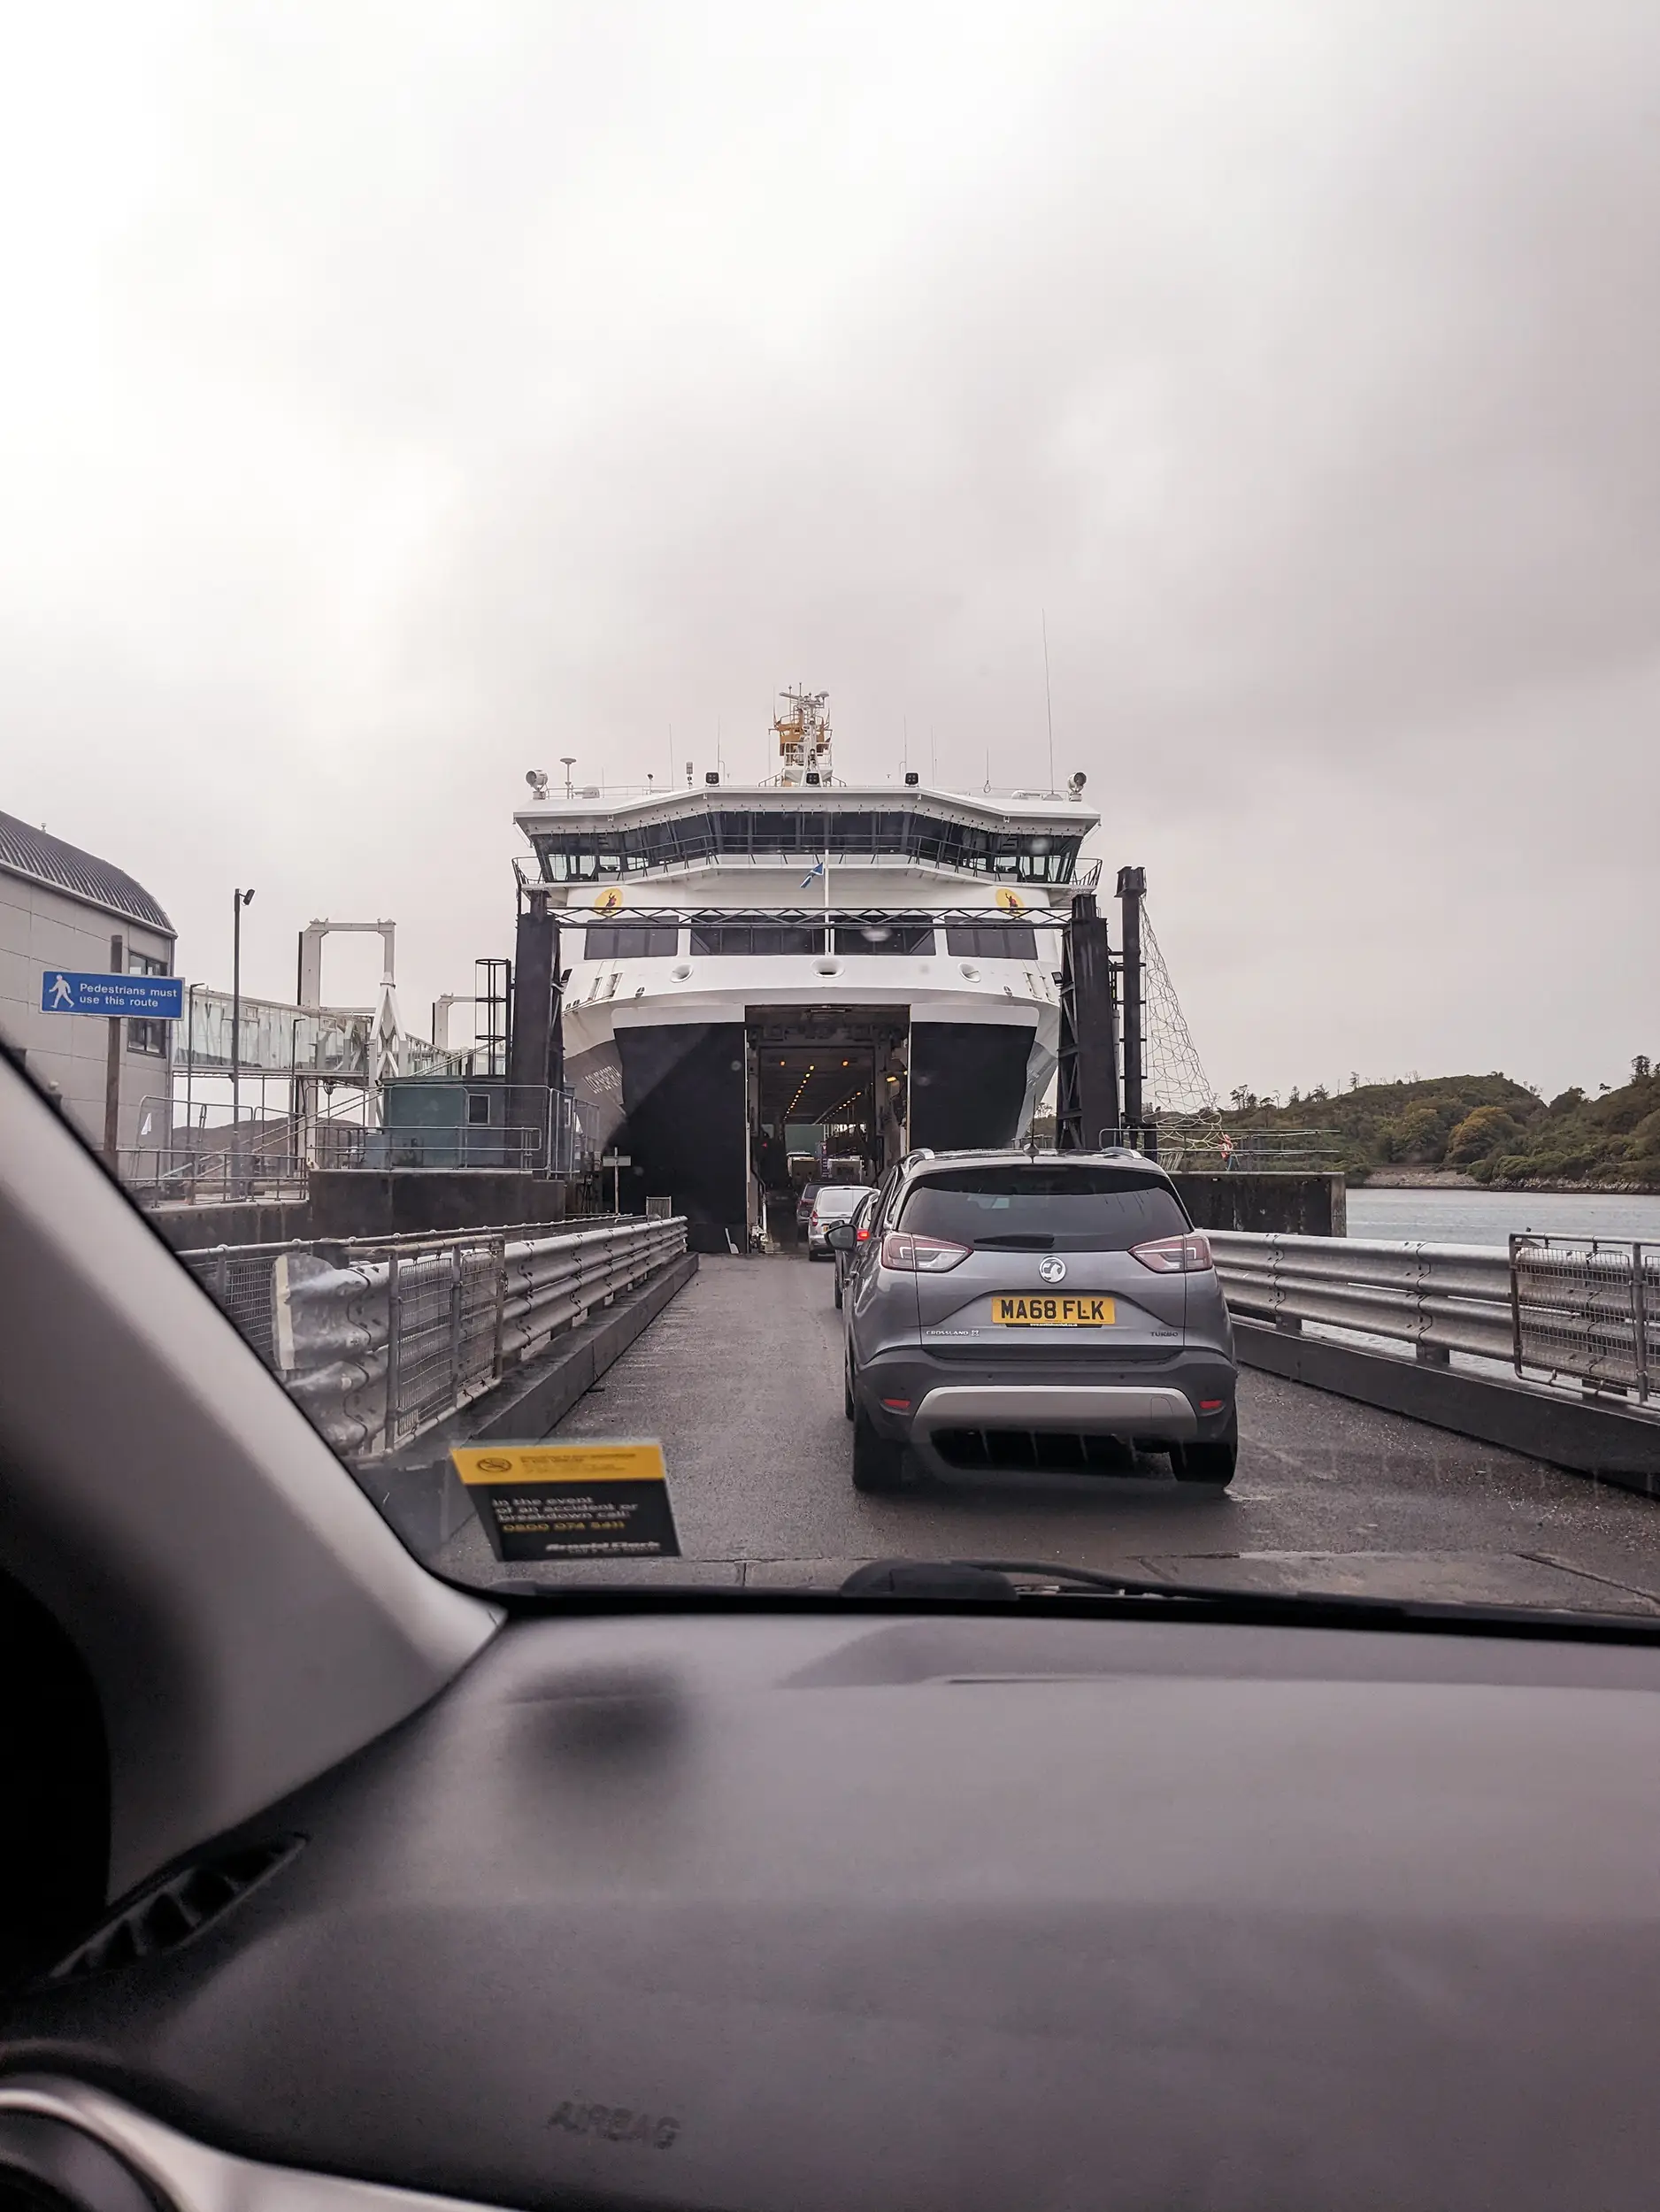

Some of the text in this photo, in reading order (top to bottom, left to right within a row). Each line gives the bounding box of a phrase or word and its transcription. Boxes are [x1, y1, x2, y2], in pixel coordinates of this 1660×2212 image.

[80, 983, 178, 997] Pedestrians must
[104, 996, 126, 1006] this
[129, 998, 159, 1008] route
[1001, 1300, 1104, 1320] MA68 FLK
[495, 1505, 512, 1514] of
[543, 1503, 615, 1513] accident
[497, 1511, 593, 1522] breakdown
[502, 1523, 549, 1532] 0800
